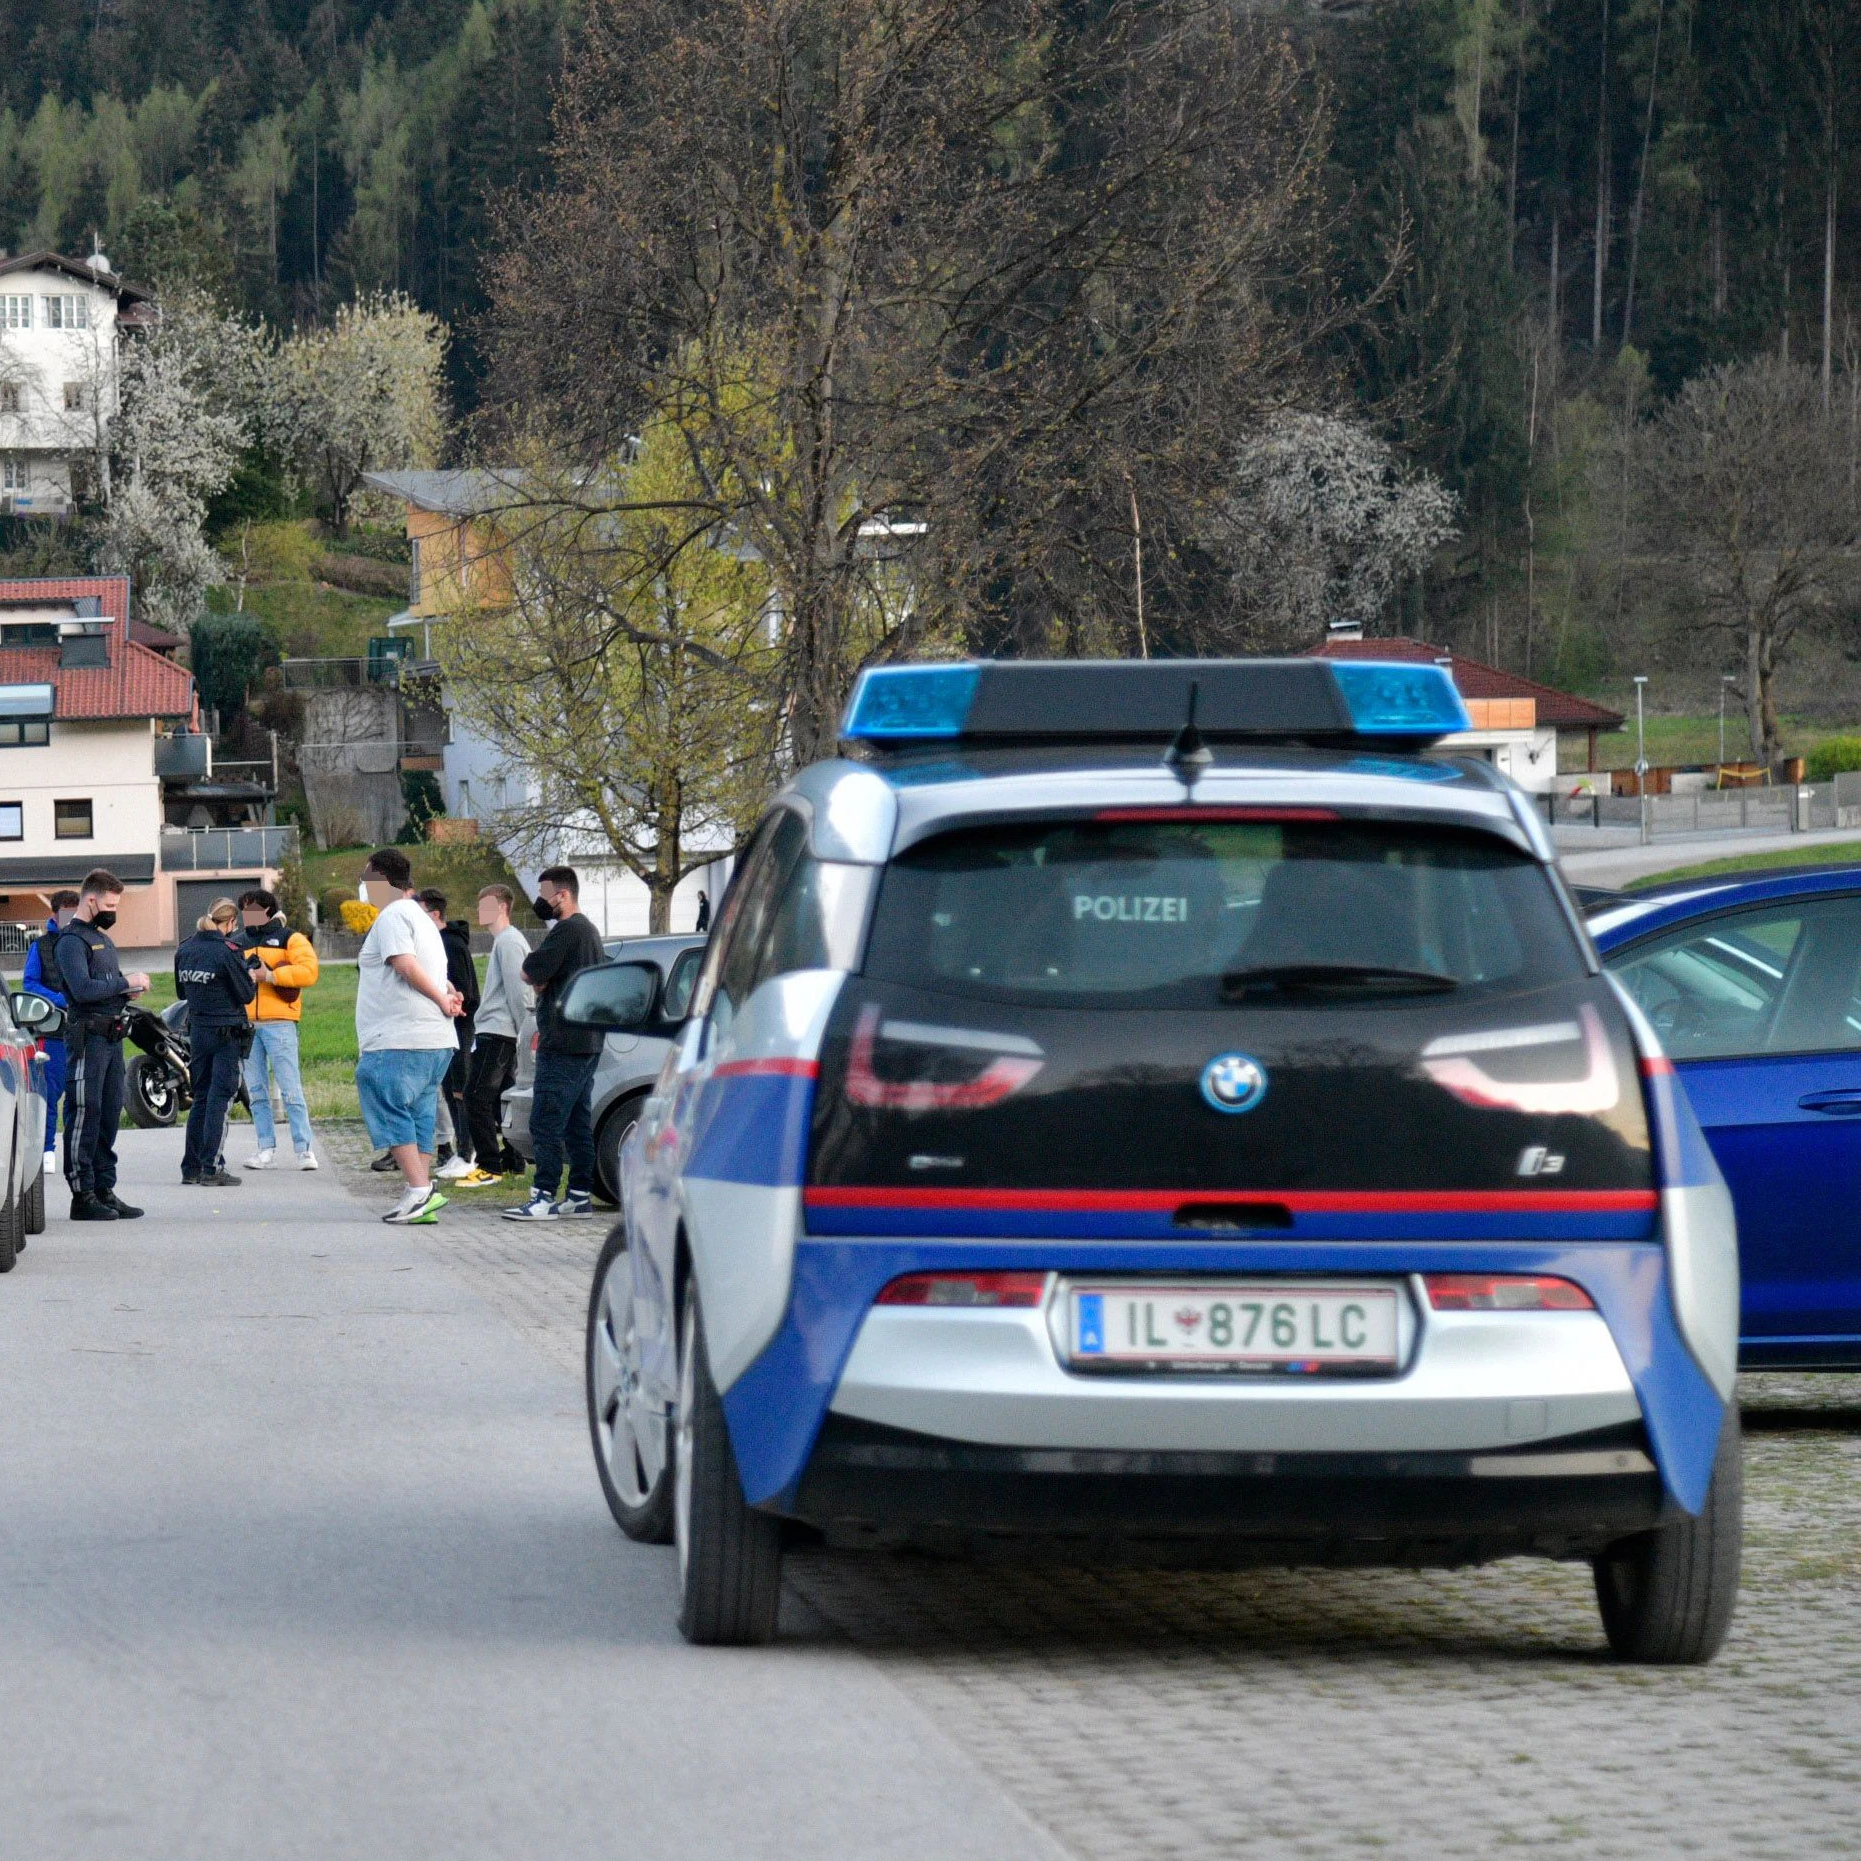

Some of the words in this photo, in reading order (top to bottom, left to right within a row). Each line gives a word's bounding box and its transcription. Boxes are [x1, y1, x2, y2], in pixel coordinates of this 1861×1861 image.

[1074, 895, 1187, 921] POLIZEI
[1084, 1332, 1099, 1346] A
[1128, 1302, 1168, 1347] IL
[1208, 1302, 1297, 1348] 876
[1311, 1304, 1366, 1349] LC
